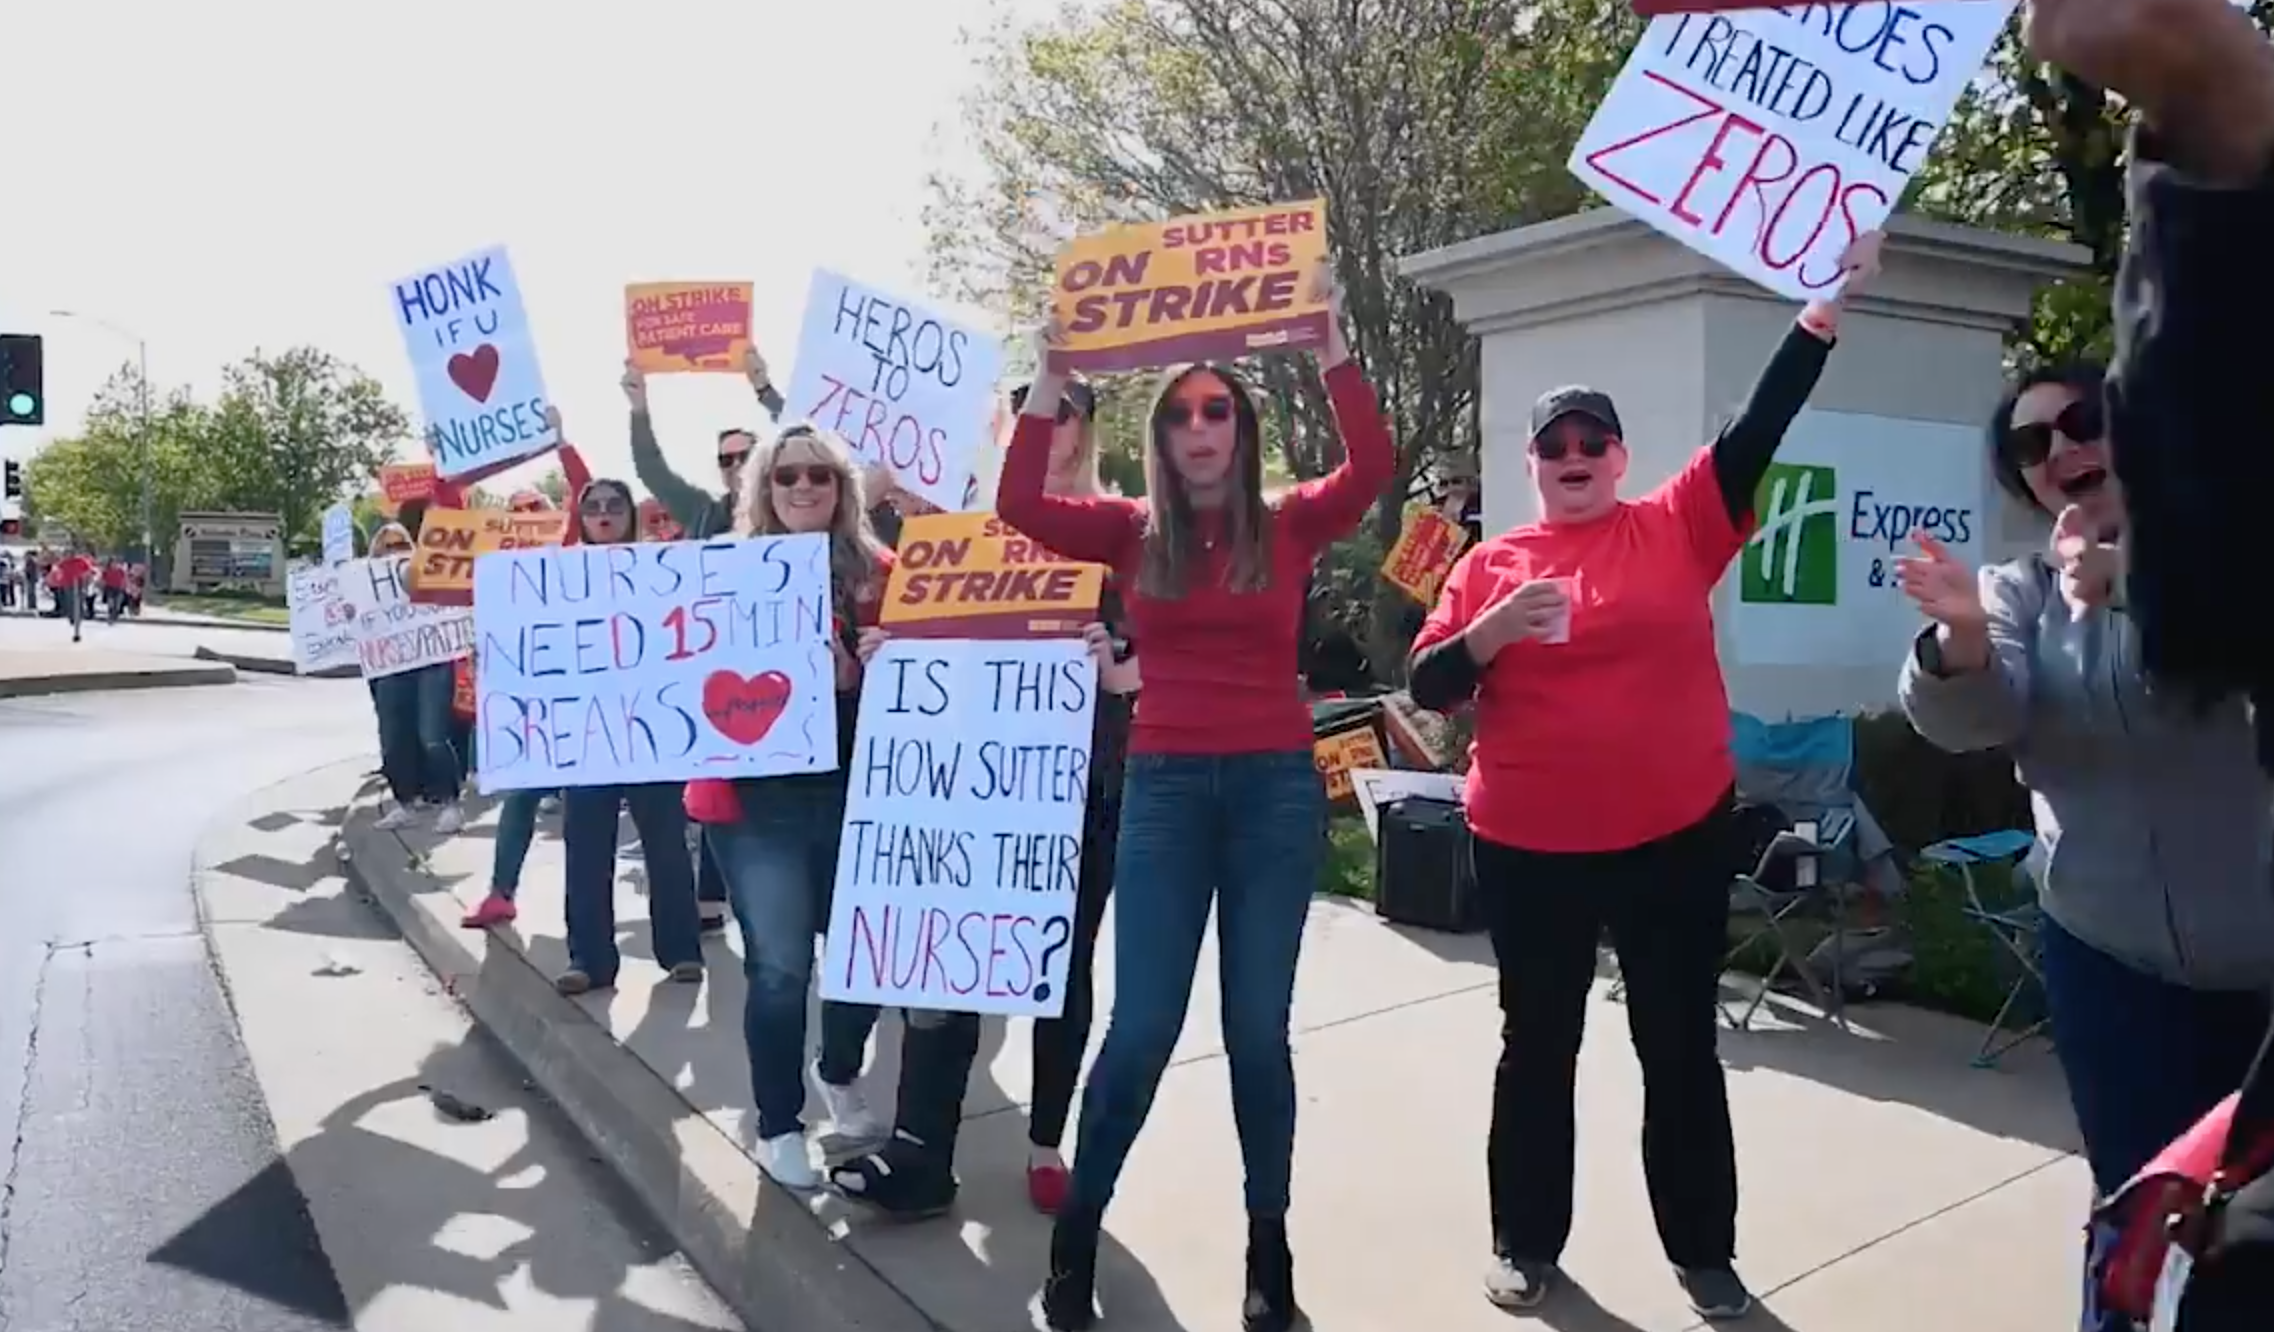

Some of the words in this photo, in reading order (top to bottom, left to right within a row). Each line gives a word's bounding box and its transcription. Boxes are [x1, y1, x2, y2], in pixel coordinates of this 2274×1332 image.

[1664, 13, 1832, 121] TREATED
[1836, 93, 1936, 175] LIKE
[1586, 69, 1888, 288] ZEROS
[1162, 211, 1314, 250] SUTTER
[396, 256, 502, 325] HONK
[1061, 250, 1152, 293] ON
[1068, 270, 1300, 333] STRIKE
[434, 318, 463, 347] IF
[474, 309, 498, 335] U
[834, 286, 967, 387] HEROS
[870, 353, 910, 401] TO
[432, 398, 550, 464] NURSES
[809, 374, 947, 486] ZEROS
[424, 527, 475, 549] ON
[1851, 490, 1972, 550] Express
[511, 540, 791, 606] NURSES
[901, 538, 971, 570] ON
[1868, 558, 1886, 588] &
[900, 569, 1082, 606] STRIKE
[483, 611, 645, 677] NEED
[662, 598, 718, 661] 15
[728, 594, 823, 648] MIN
[886, 658, 949, 716] IS
[984, 660, 1086, 712] THIS
[483, 682, 697, 774] BREAKS
[865, 736, 962, 801] HOW
[970, 740, 1088, 804] SUTTER
[849, 820, 976, 888] THANKS
[992, 833, 1080, 891] THEIR
[846, 903, 1070, 1003] NURSES?
